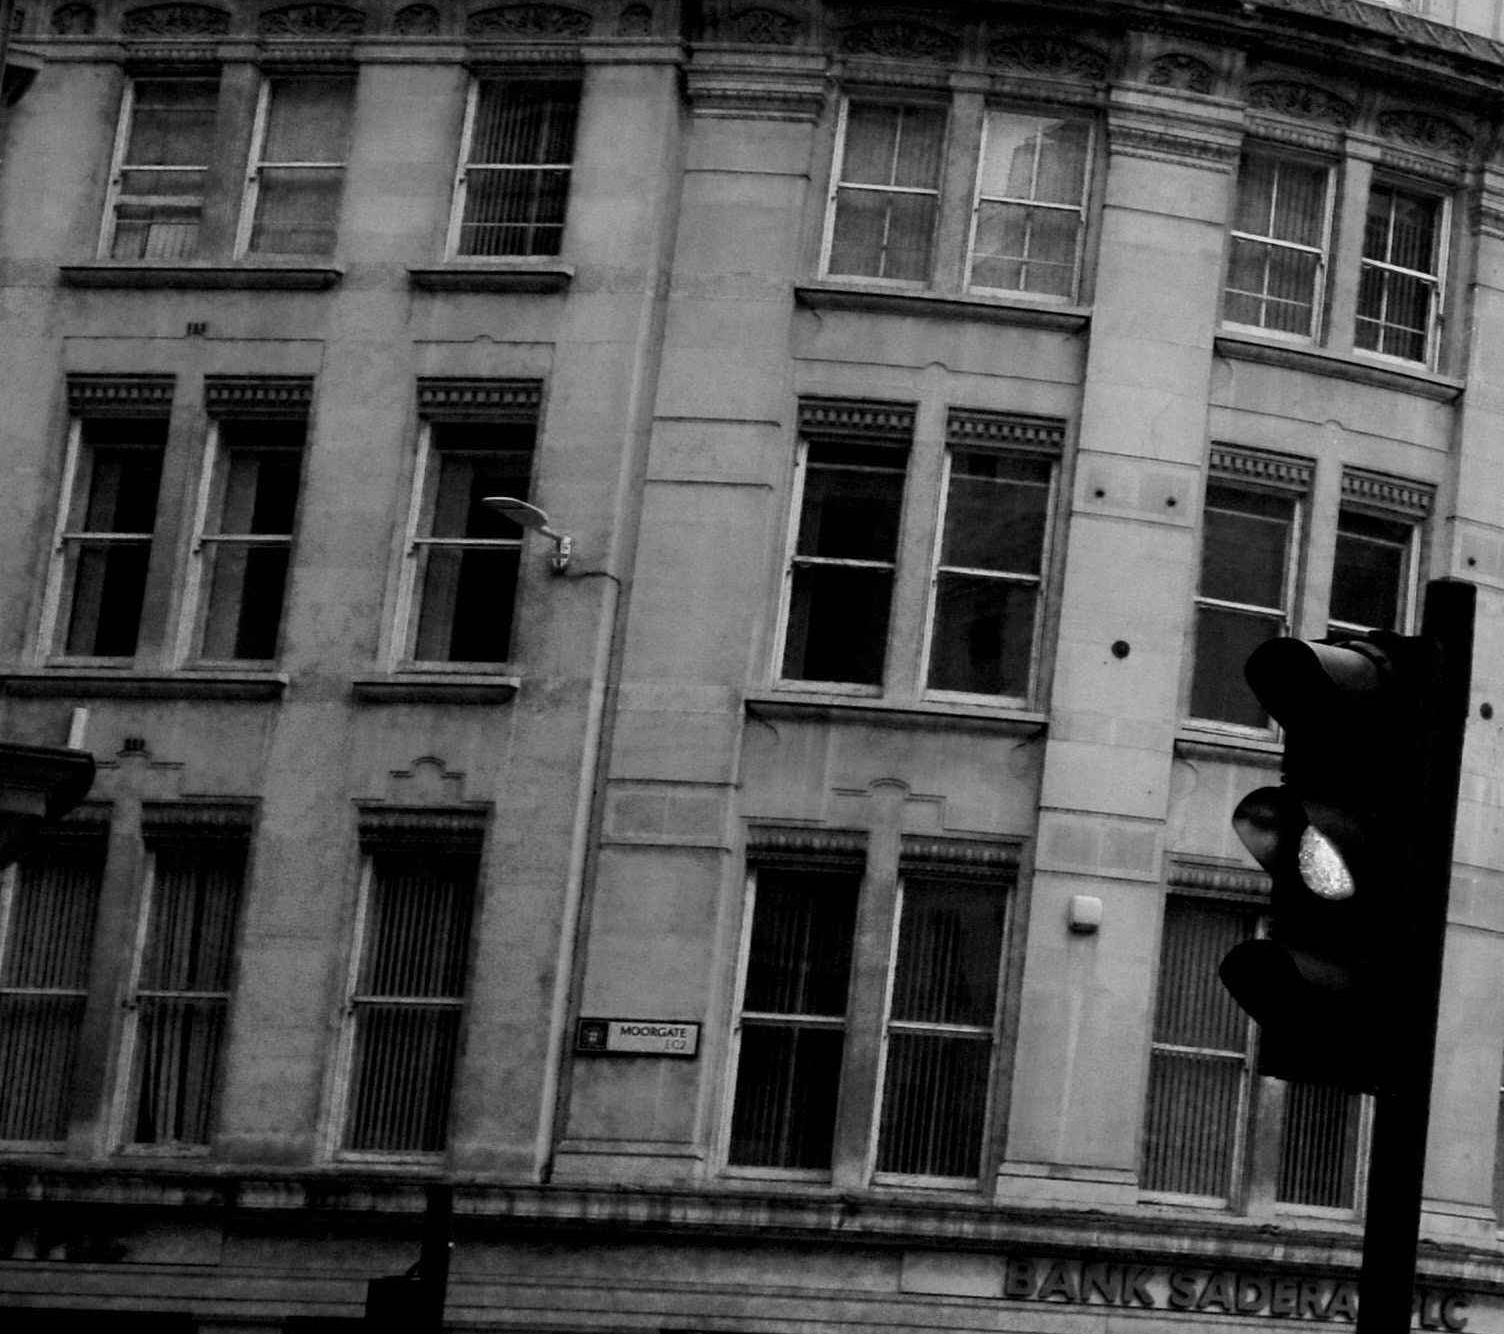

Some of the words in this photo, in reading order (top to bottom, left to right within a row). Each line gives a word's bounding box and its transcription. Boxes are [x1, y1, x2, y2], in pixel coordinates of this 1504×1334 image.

[620, 1026, 687, 1038] MOORGATE
[1004, 1256, 1155, 1307] BANK
[1167, 1268, 1360, 1321] SADERA
[1413, 1288, 1469, 1331] LC
